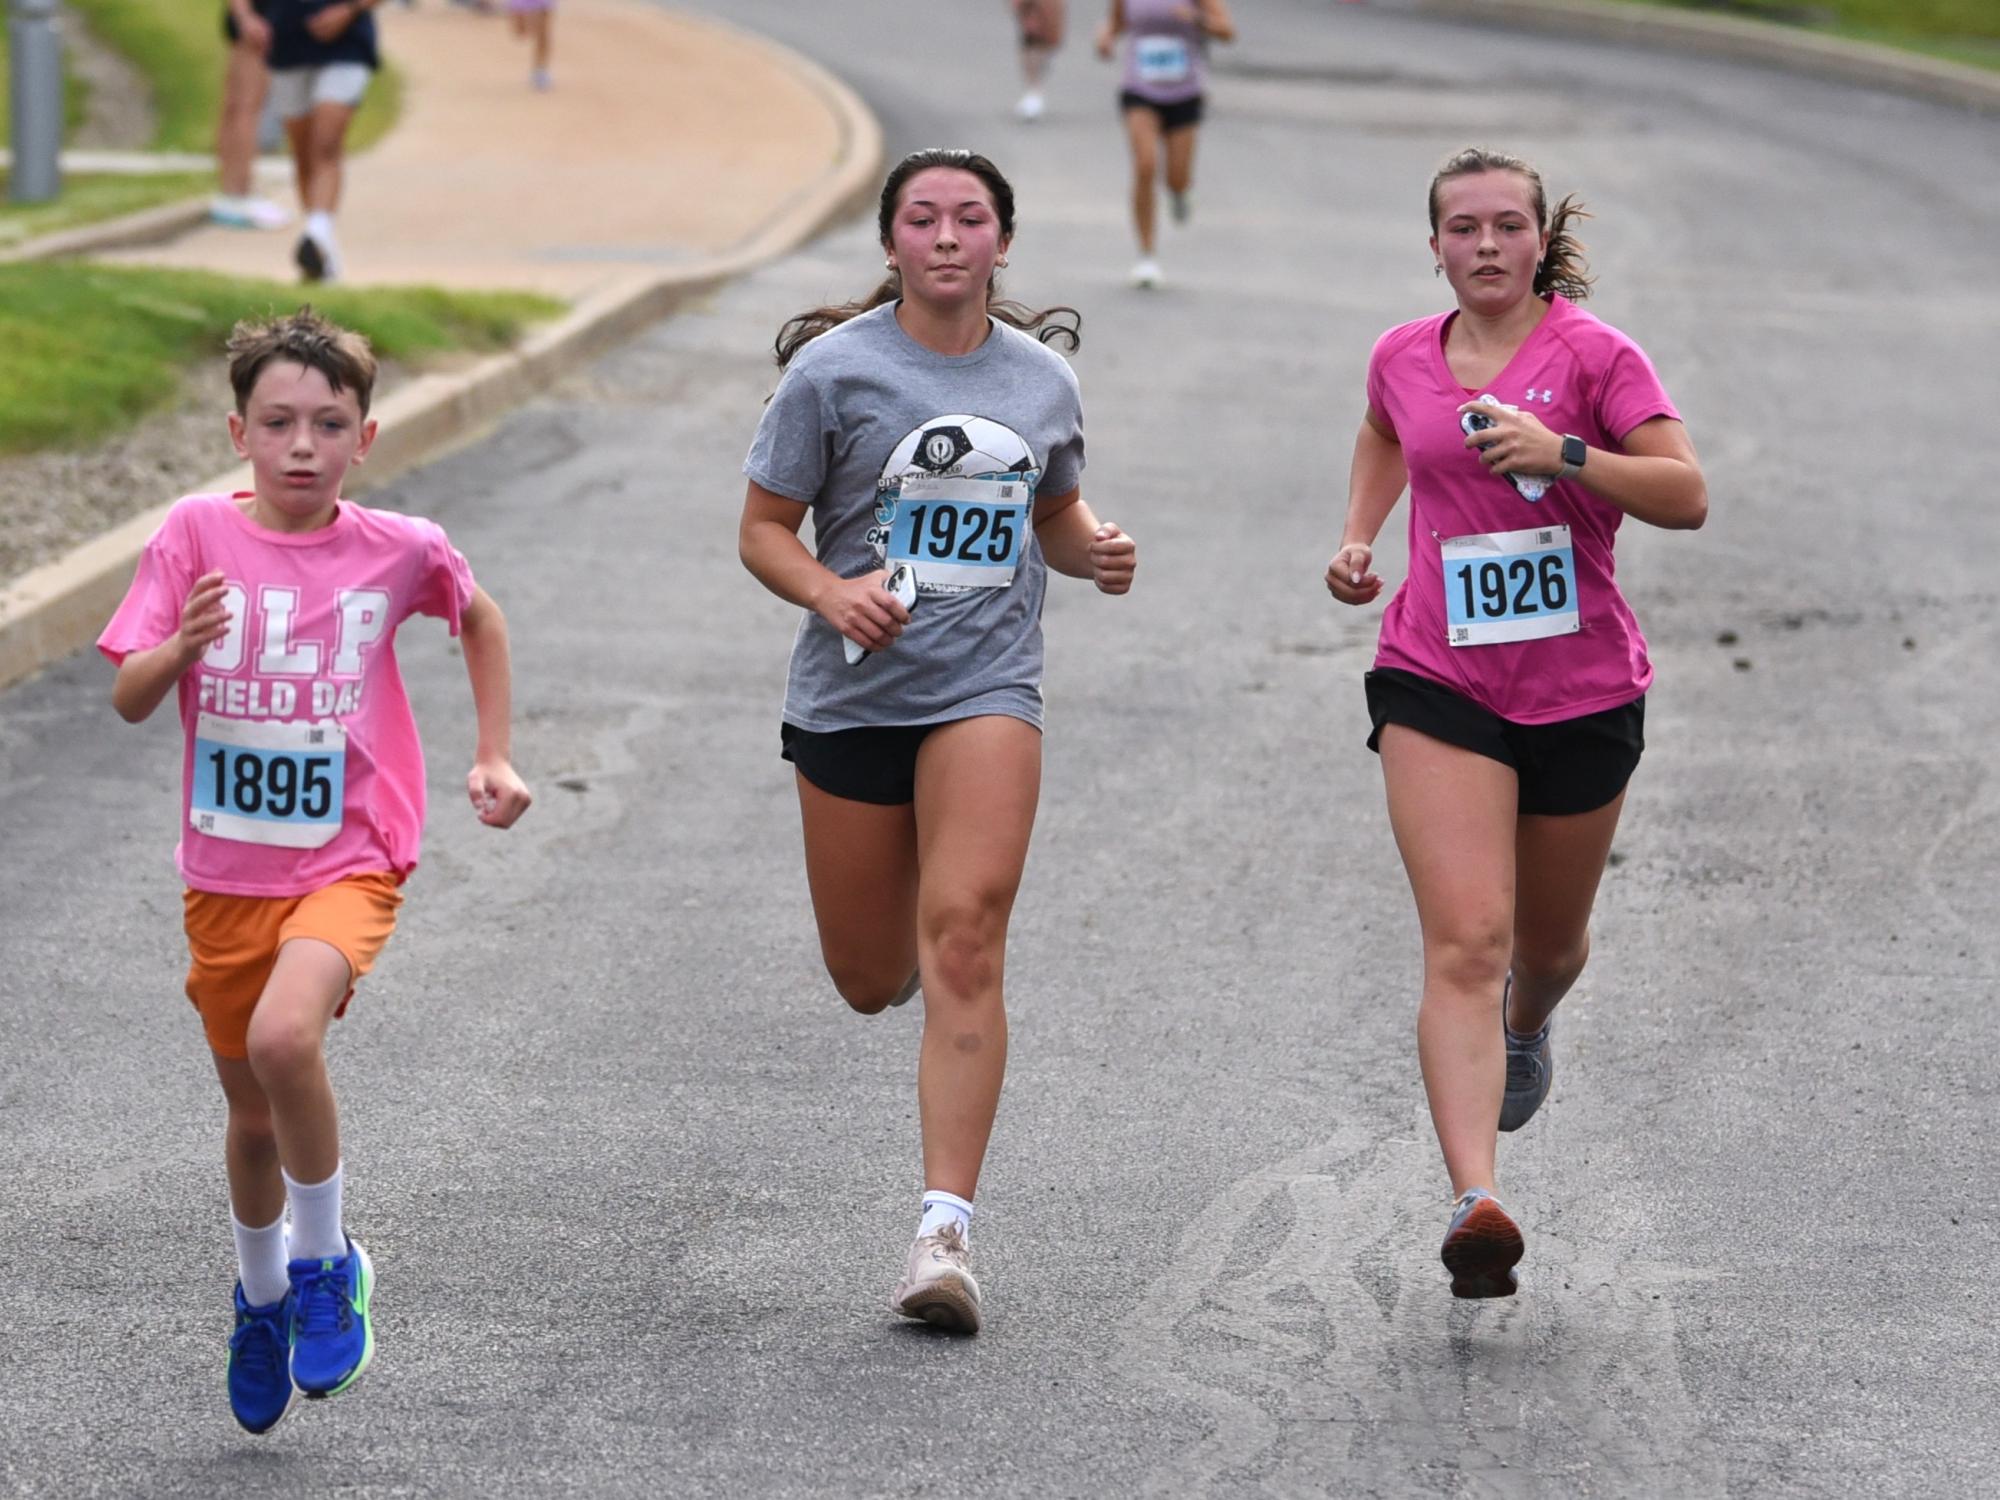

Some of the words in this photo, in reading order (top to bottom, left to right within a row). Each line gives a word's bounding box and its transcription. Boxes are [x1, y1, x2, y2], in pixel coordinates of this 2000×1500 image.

[908, 505, 1016, 562] 1925
[1457, 555, 1568, 618] 1926
[200, 580, 391, 678] OLP
[198, 674, 297, 716] FIELD
[209, 748, 332, 821] 1895
